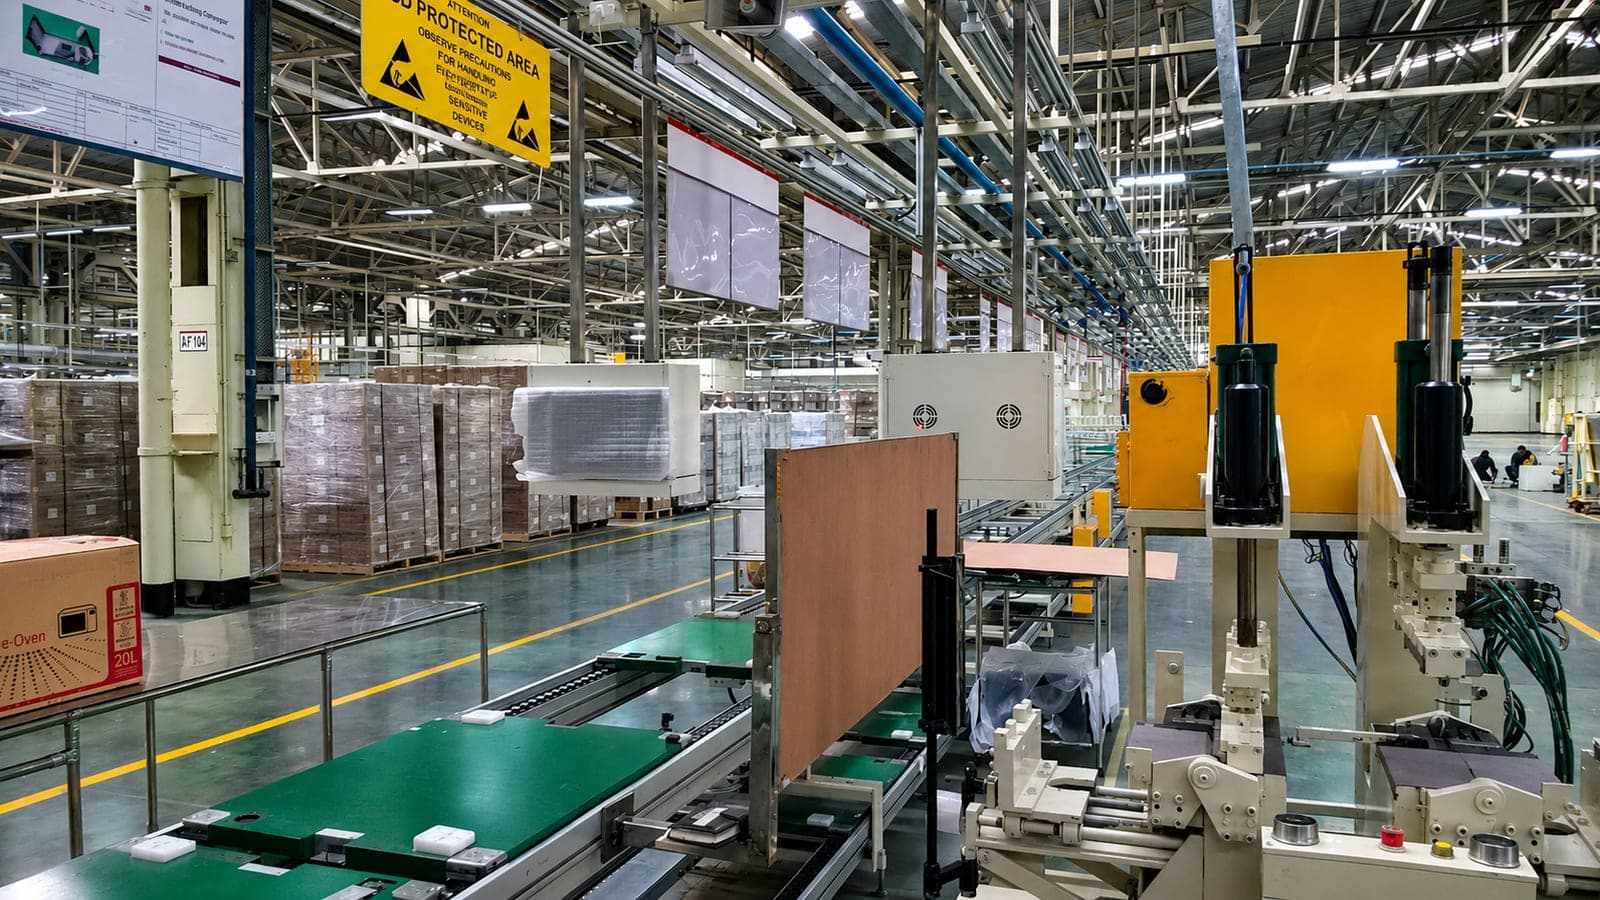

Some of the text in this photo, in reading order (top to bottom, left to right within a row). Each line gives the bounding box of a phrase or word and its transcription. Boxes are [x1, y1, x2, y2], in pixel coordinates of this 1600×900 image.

[447, 0, 491, 30] ATTENTION
[416, 0, 504, 59] PROTECTED
[506, 50, 541, 81] AREA
[417, 26, 512, 82] OBSERVE PRECAUTIONS
[437, 51, 497, 87] FOR HANDLING
[448, 94, 488, 121] SENSITIVE
[452, 111, 486, 133] DEVICES
[114, 650, 137, 668] 20L
